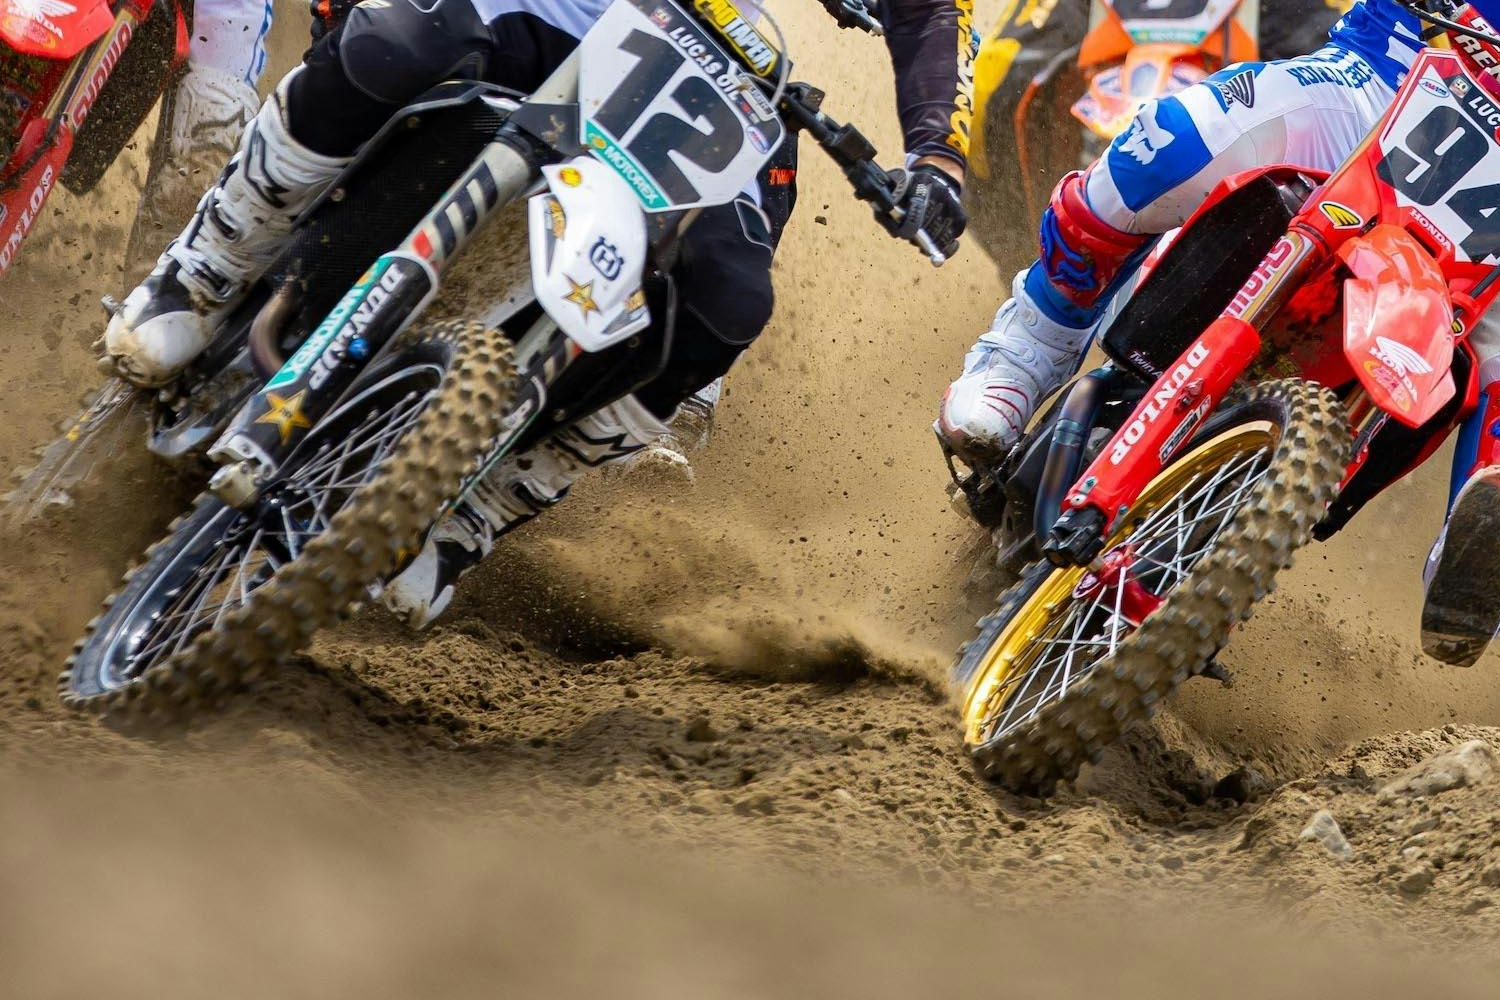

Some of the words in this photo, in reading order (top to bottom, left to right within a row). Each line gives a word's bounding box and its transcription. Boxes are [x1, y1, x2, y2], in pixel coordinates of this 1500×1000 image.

[669, 26, 723, 75] LUCAS
[715, 73, 741, 101] OIL
[593, 27, 745, 207] 12
[604, 145, 657, 206] MOTOREX
[1410, 207, 1454, 252] HONDA
[1109, 341, 1211, 466] DUNLOP
[1369, 347, 1418, 401] HONDA
